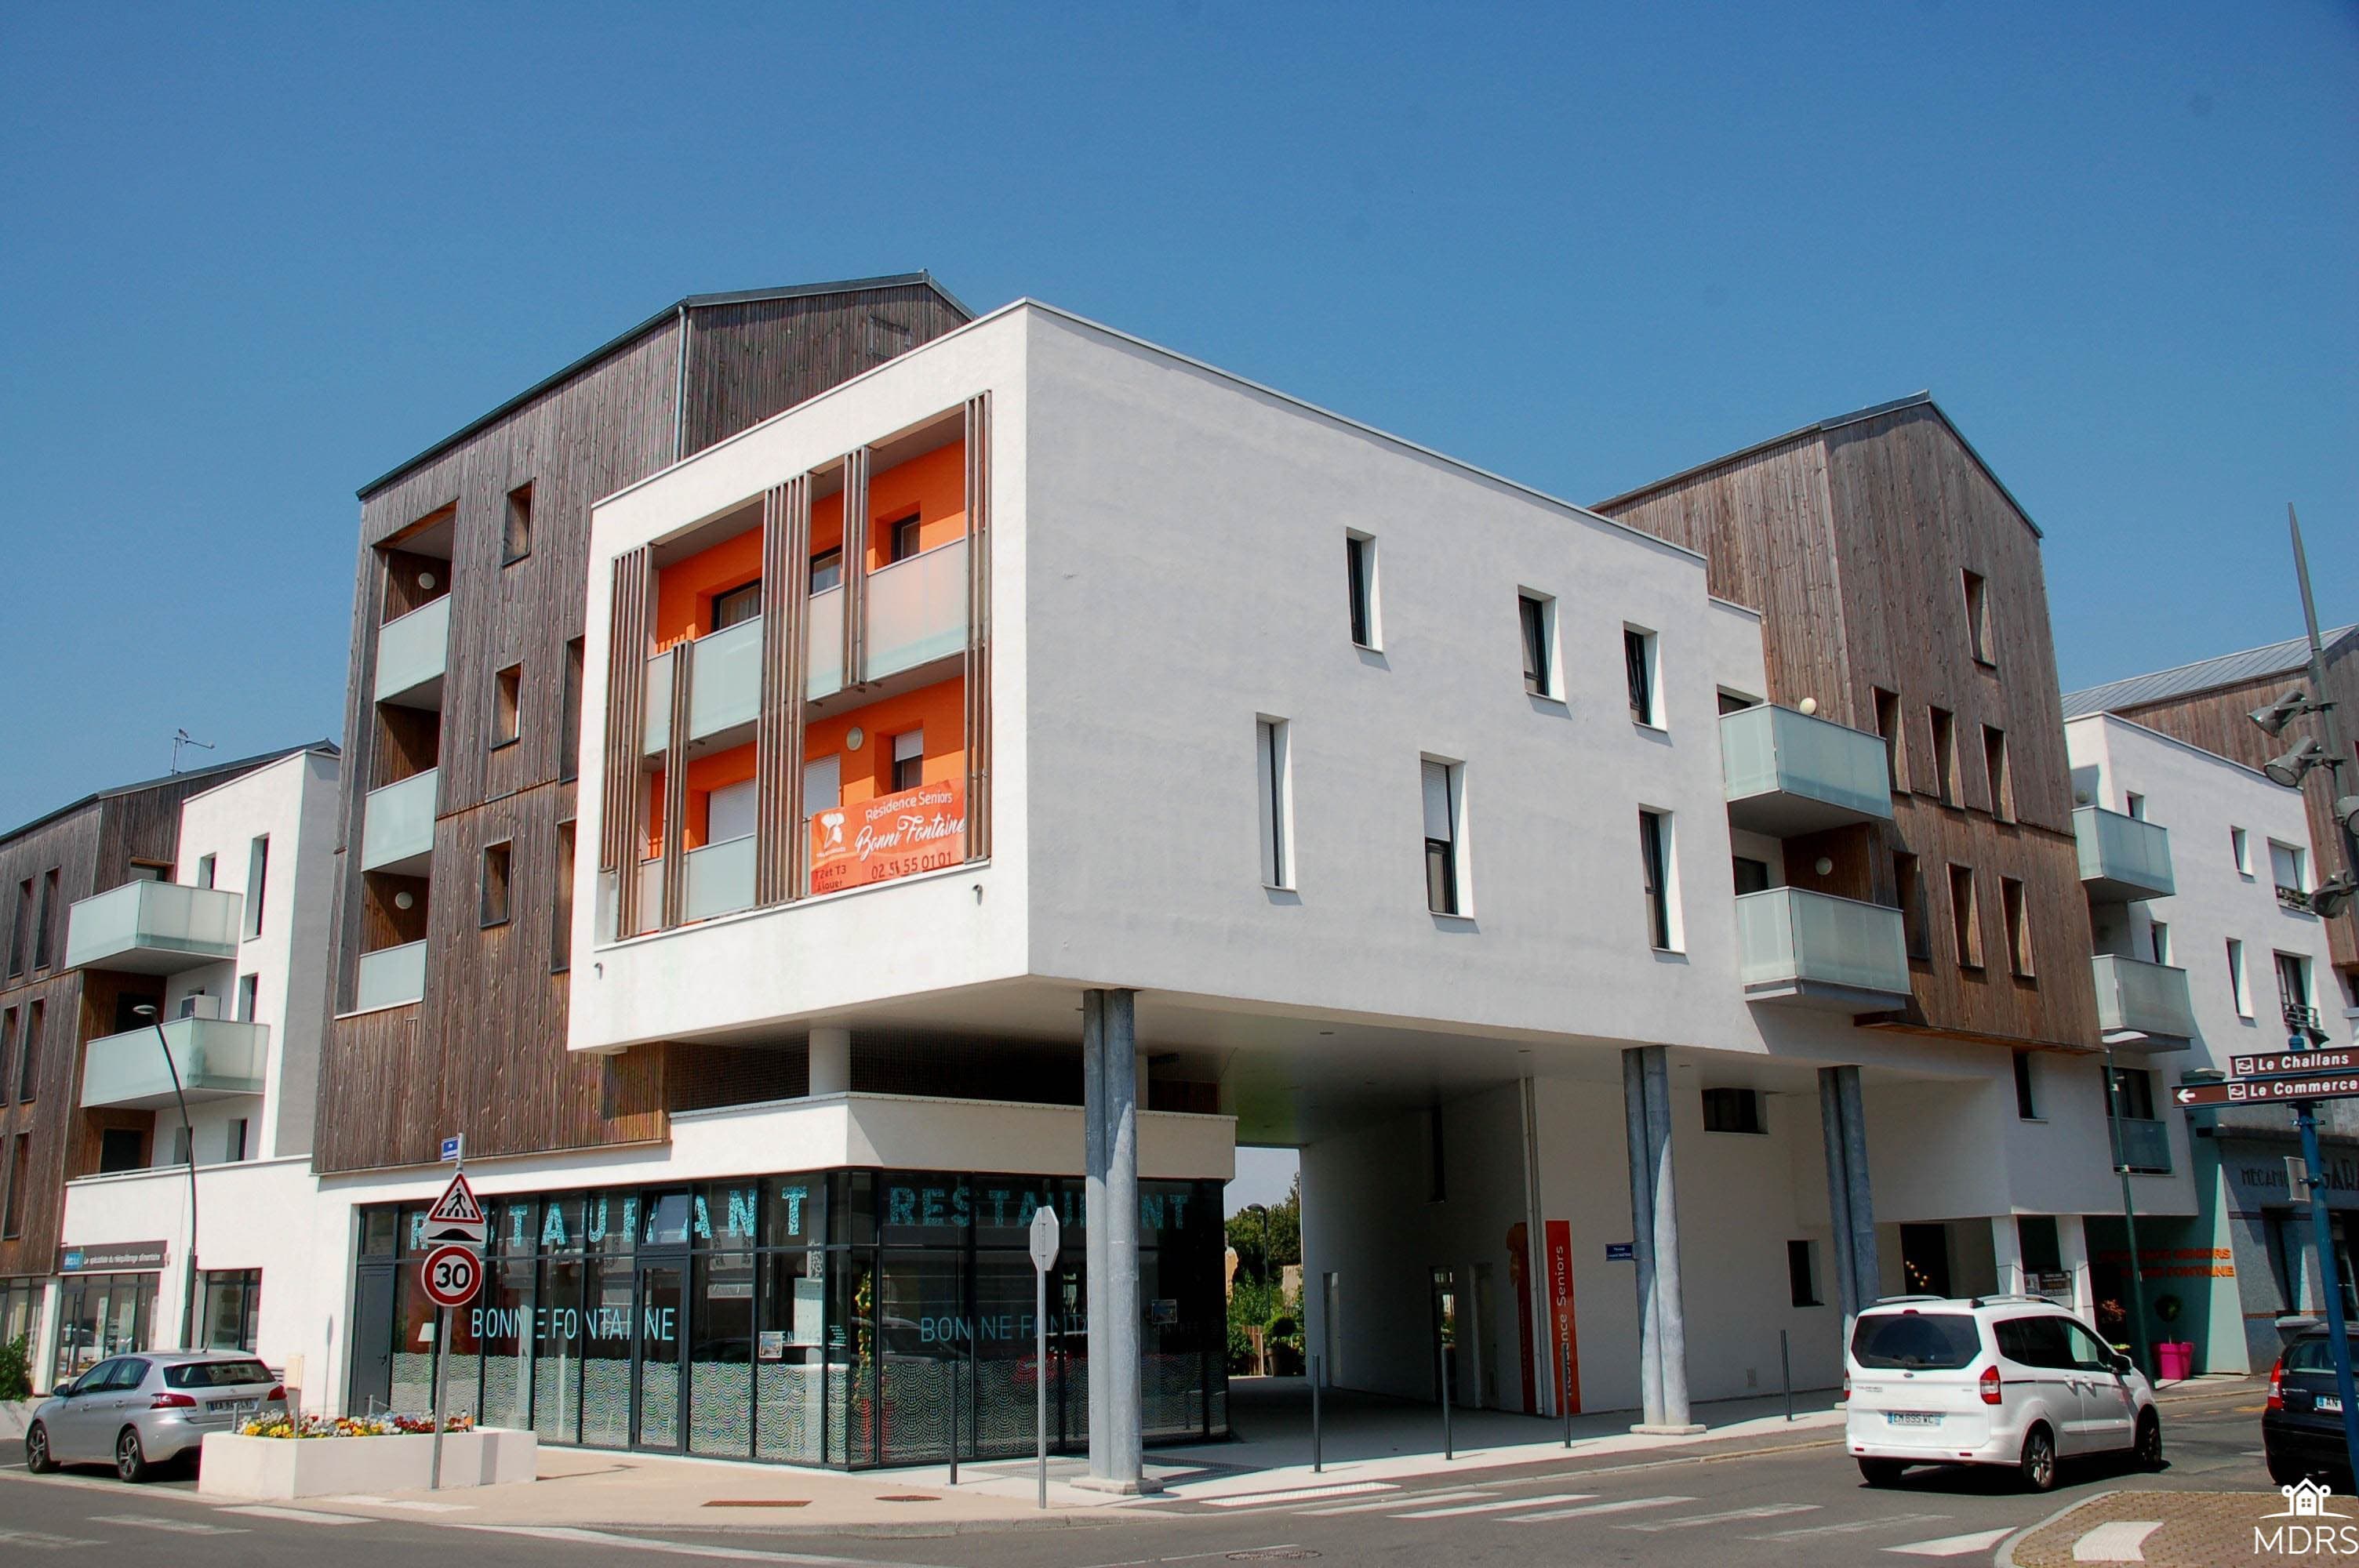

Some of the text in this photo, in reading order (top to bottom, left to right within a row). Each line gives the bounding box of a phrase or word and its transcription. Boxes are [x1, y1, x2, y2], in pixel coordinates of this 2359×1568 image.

[865, 790, 953, 822] Résidence Seniors
[897, 811, 966, 844] Fontaine
[836, 865, 846, 876] T3
[871, 864, 885, 880] 02
[903, 858, 918, 873] 55
[922, 855, 936, 869] 01
[939, 852, 952, 866] 01
[2258, 1053, 2350, 1072] Le Challans
[2250, 1078, 2357, 1097] Le Commerce
[435, 1262, 471, 1289] 30
[1554, 1245, 1567, 1307] Seniors
[920, 1315, 1012, 1343] BONNE
